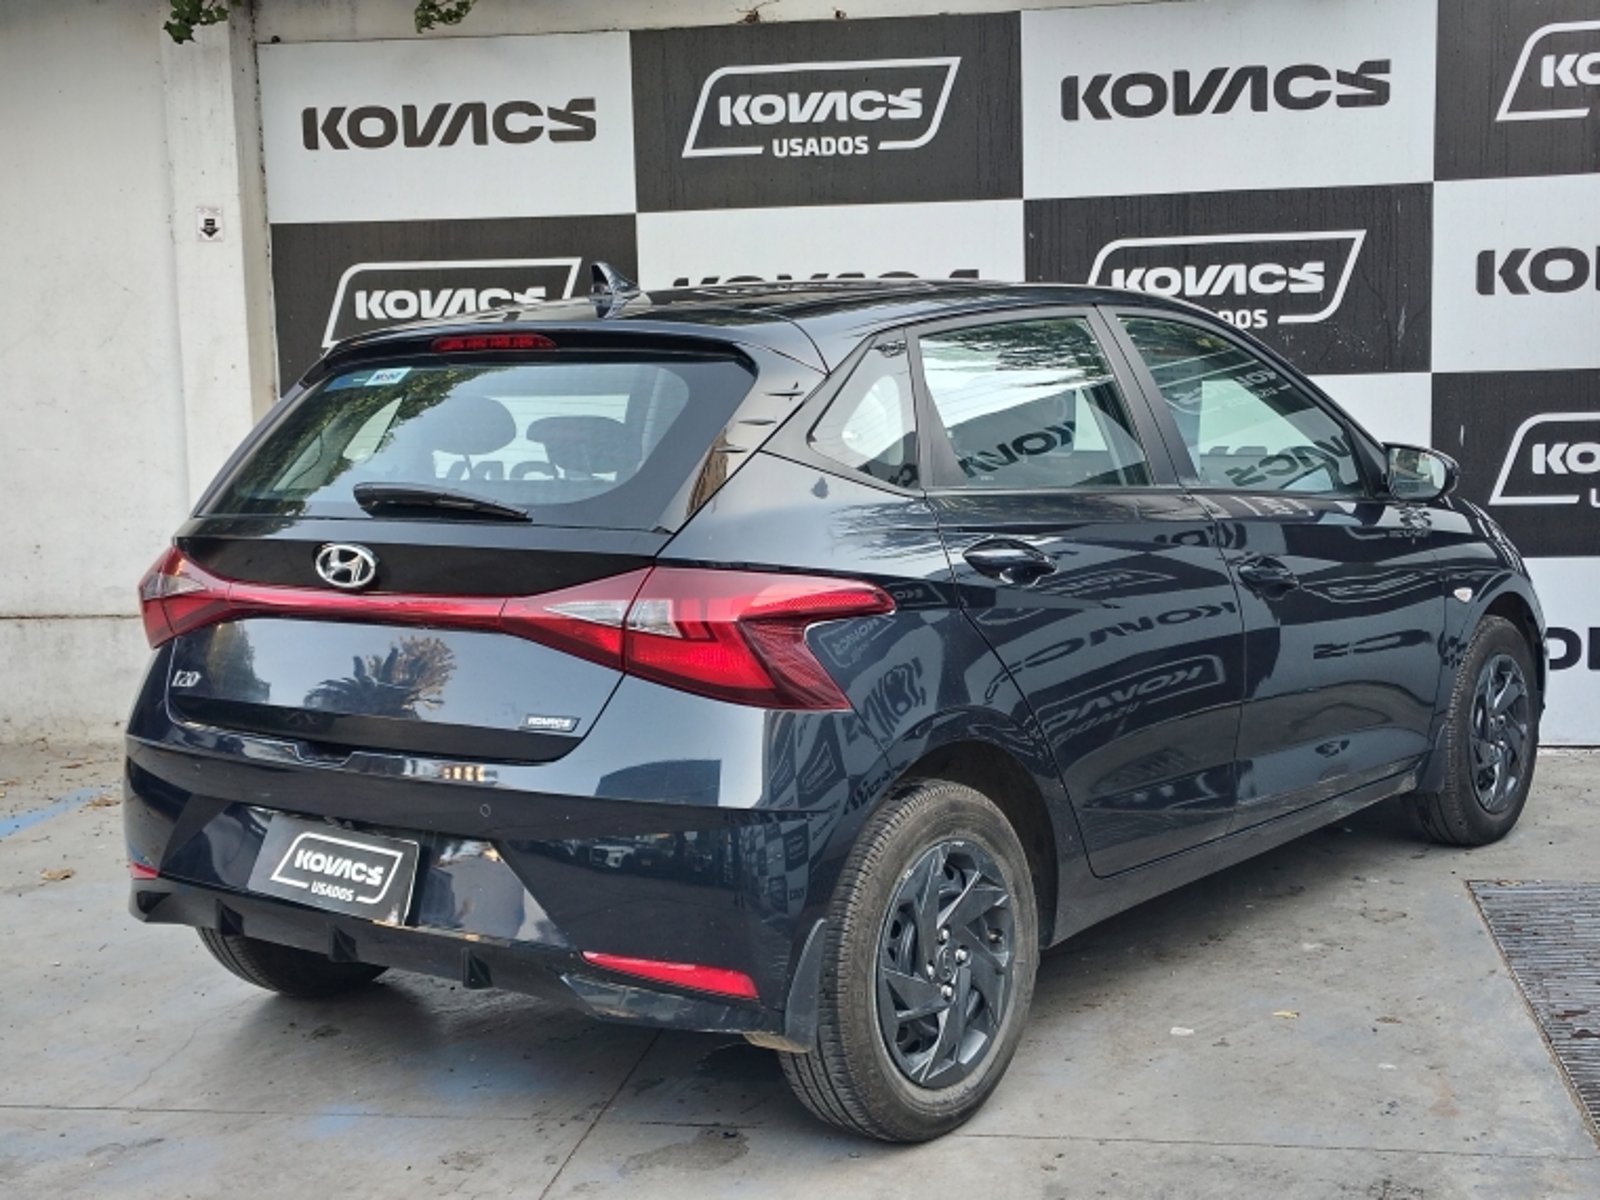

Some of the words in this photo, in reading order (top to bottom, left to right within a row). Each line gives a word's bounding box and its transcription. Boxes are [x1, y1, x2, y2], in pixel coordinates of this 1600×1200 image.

[719, 88, 922, 126] KOVACS
[1060, 59, 1391, 121] KOVACS
[302, 97, 596, 150] KOVACS
[772, 136, 869, 158] USADOS
[1111, 261, 1325, 297] KOVACS
[1475, 246, 1600, 295] KO
[1218, 309, 1268, 330] DOS
[294, 850, 384, 886] KOVACS
[311, 881, 354, 902] USADOS
